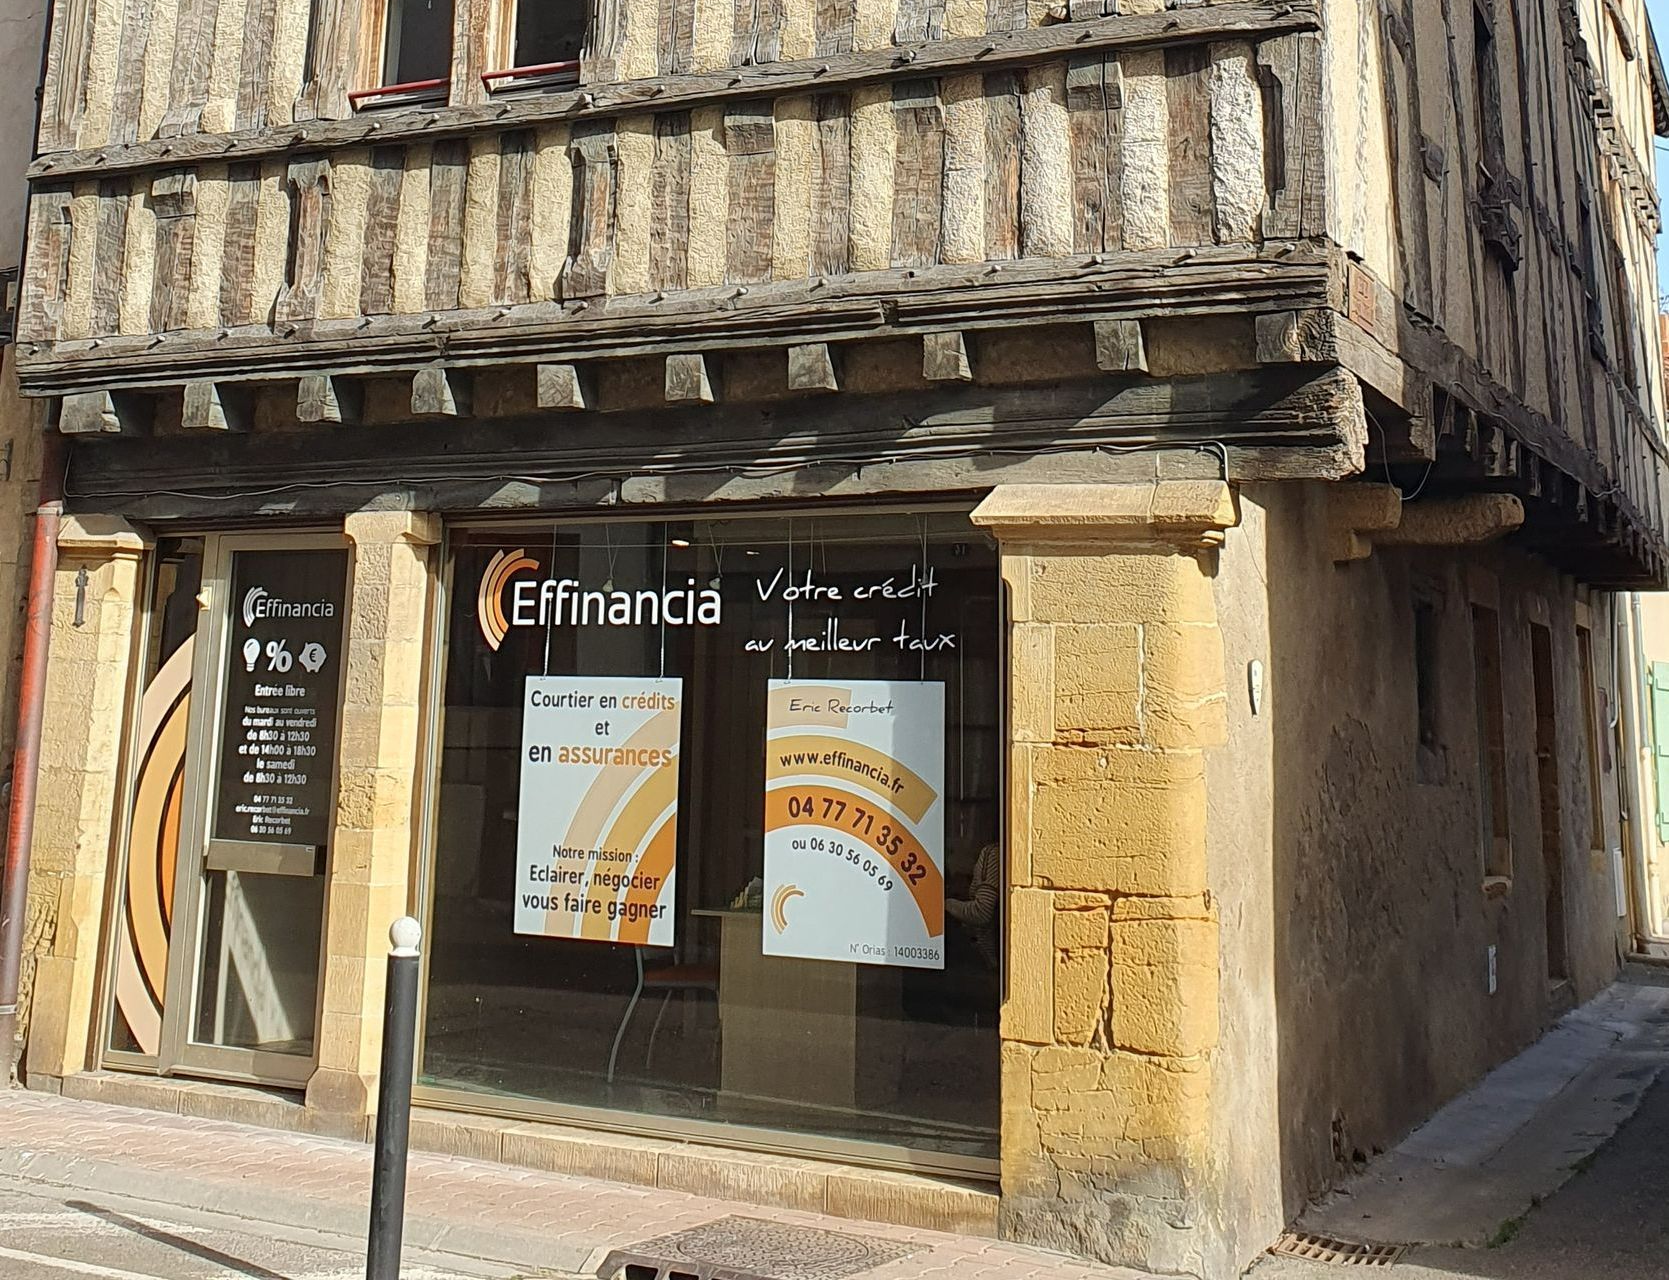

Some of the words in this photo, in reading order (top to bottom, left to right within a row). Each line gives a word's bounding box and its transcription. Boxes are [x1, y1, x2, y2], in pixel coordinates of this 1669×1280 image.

[756, 567, 843, 601] Votre
[853, 563, 939, 600] crédit
[255, 598, 334, 618] Effinancia
[512, 578, 722, 626] Effinancia
[744, 638, 774, 652] au
[784, 617, 882, 652] meilleur
[892, 618, 956, 651] taux
[265, 638, 293, 673] %
[254, 683, 284, 697] Entrée
[285, 684, 306, 697] libre
[530, 690, 595, 709] Courtier
[599, 695, 617, 709] en
[621, 691, 675, 710] crédits
[789, 698, 821, 712] Eric
[828, 698, 894, 714] Recorbet
[242, 716, 252, 727] du
[252, 716, 274, 727] mardi
[275, 719, 284, 727] au
[286, 718, 318, 728] vendredi
[595, 720, 610, 736] et
[287, 731, 310, 742] 12h30
[238, 745, 248, 755] et
[249, 743, 260, 755] de
[261, 744, 285, 755] 14h00
[528, 745, 551, 763] en
[558, 745, 673, 768] assurances
[256, 757, 265, 769] le
[266, 759, 296, 770] samedi
[780, 750, 904, 794] www.effinancia.fr
[243, 771, 254, 783] de
[284, 773, 307, 785] 12h30
[788, 796, 814, 818] 04
[822, 797, 847, 822] 77
[852, 807, 875, 835] 71
[876, 825, 903, 856] 35
[900, 852, 927, 886] 32
[552, 844, 585, 859] Notre
[588, 847, 632, 862] mission
[792, 839, 807, 850] ou
[810, 837, 825, 851] 06
[828, 841, 843, 857] 30
[845, 849, 860, 865] 56
[862, 860, 879, 877] 05
[877, 875, 893, 891] 69
[529, 864, 589, 888] Eclairer,
[593, 867, 661, 892] négocier
[522, 893, 559, 911] vous
[564, 892, 602, 914] faire
[607, 898, 667, 923] gagner
[862, 944, 886, 956] Orias
[894, 946, 940, 961] 14003386
